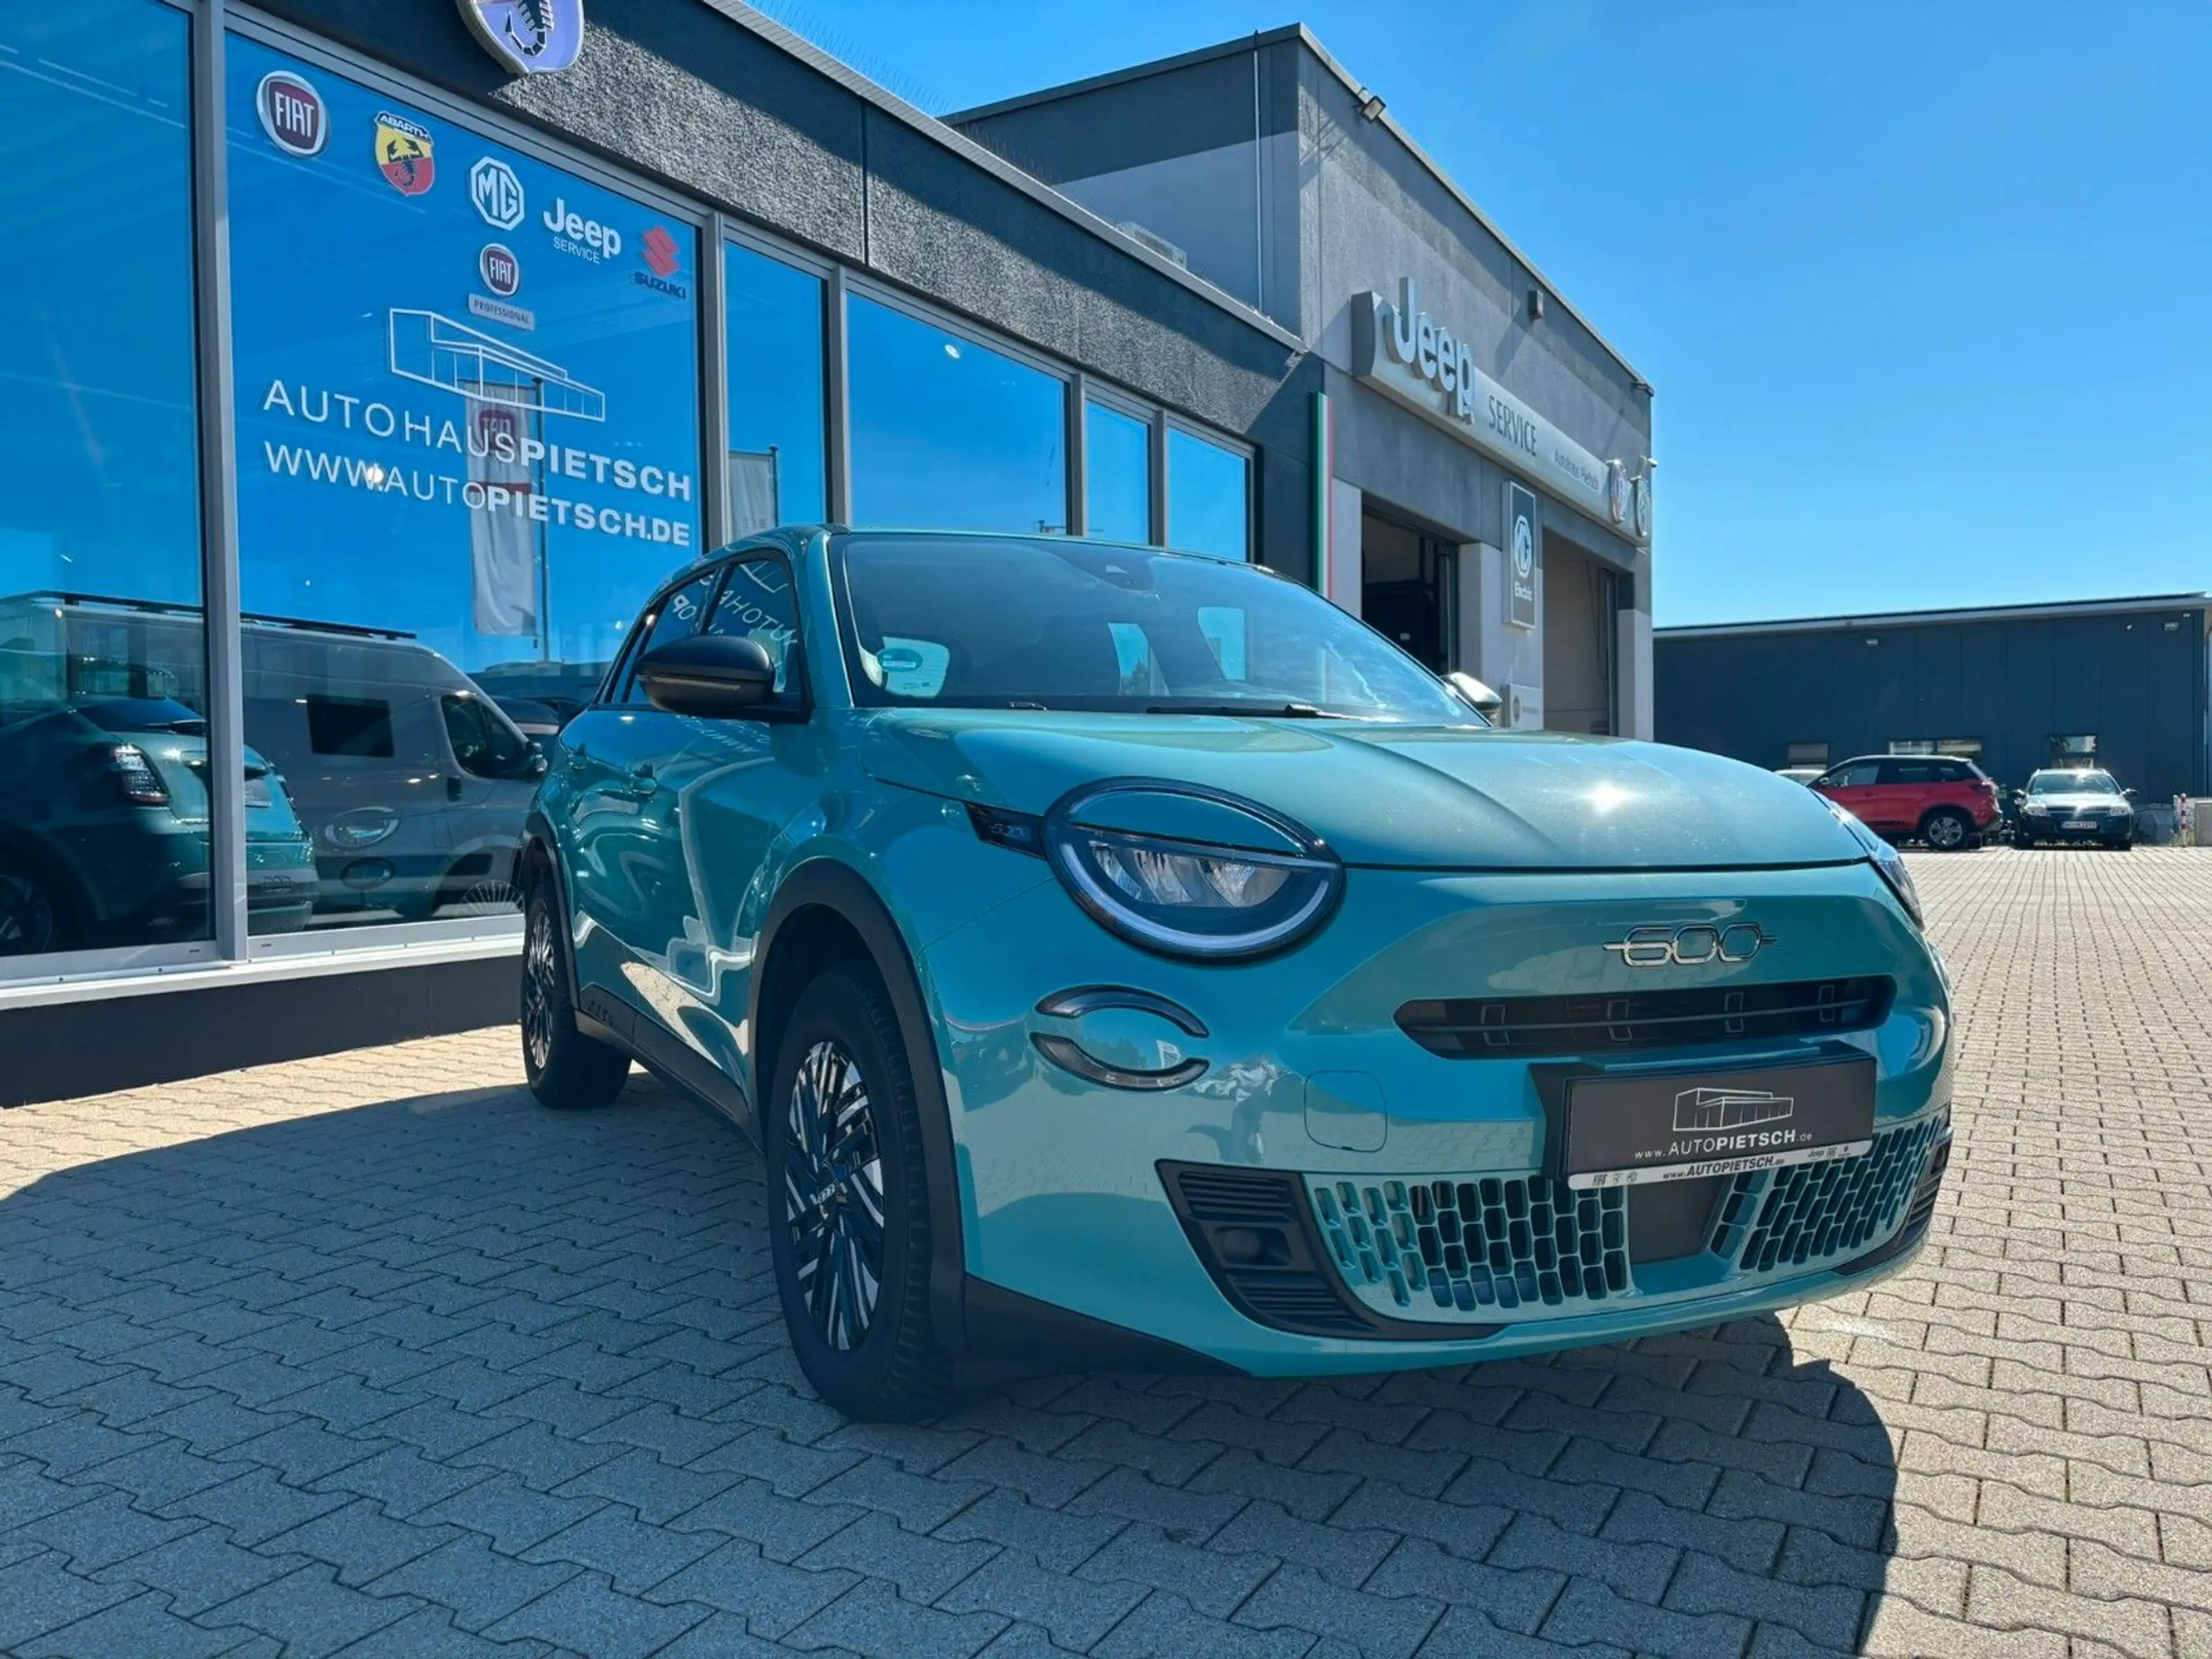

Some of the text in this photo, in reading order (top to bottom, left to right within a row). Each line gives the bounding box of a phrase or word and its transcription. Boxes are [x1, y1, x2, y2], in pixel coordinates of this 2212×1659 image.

[274, 92, 315, 138] FIAT
[380, 115, 431, 140] ABARTH
[478, 166, 518, 221] MG
[543, 197, 621, 259] Jeep
[490, 257, 513, 284] FIAT
[552, 236, 600, 265] SERVICE
[634, 271, 687, 300] SUZUKI
[474, 298, 530, 324] PROFESSIONAL
[1385, 276, 1476, 425] Jeep
[1488, 395, 1537, 457] SERVICE
[264, 440, 690, 547] WWW.AUTOPIETSCH.DE
[1622, 923, 1763, 967] 600
[1635, 1129, 1812, 1160] www.AUTOPIETSCH.de
